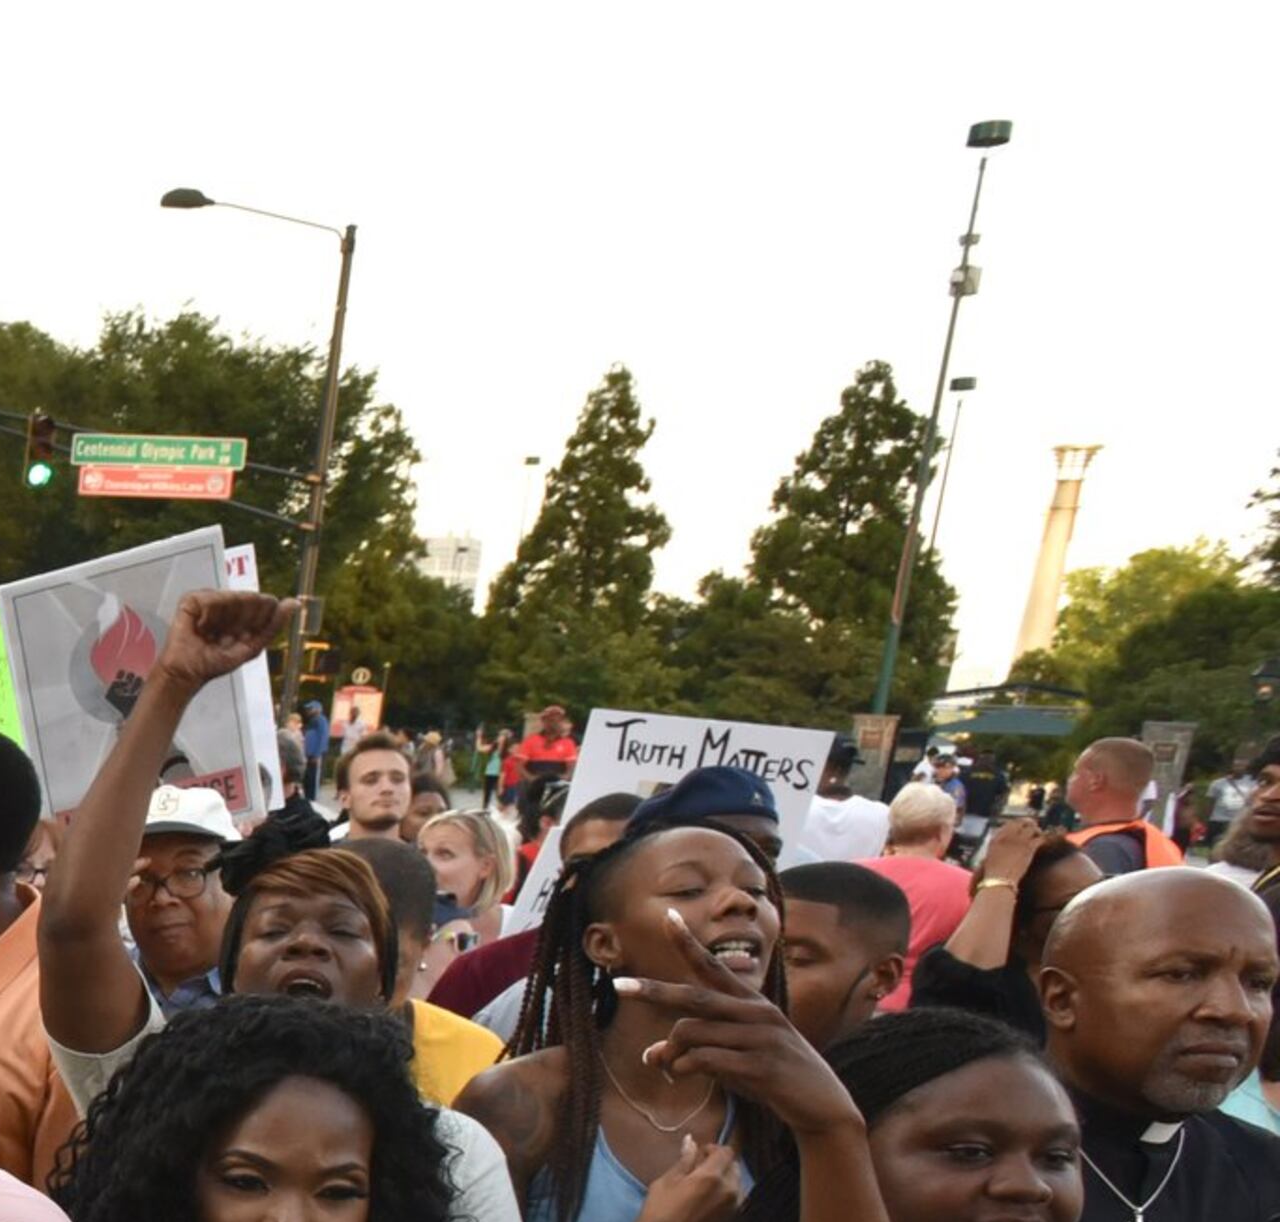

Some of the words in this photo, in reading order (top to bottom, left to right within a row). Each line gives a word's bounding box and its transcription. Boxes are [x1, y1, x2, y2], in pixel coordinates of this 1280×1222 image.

[76, 440, 137, 458] Centennial
[141, 442, 186, 462] Olympic
[190, 444, 216, 460] Park
[605, 717, 688, 769] TRUTH
[696, 726, 815, 790] MATTERS
